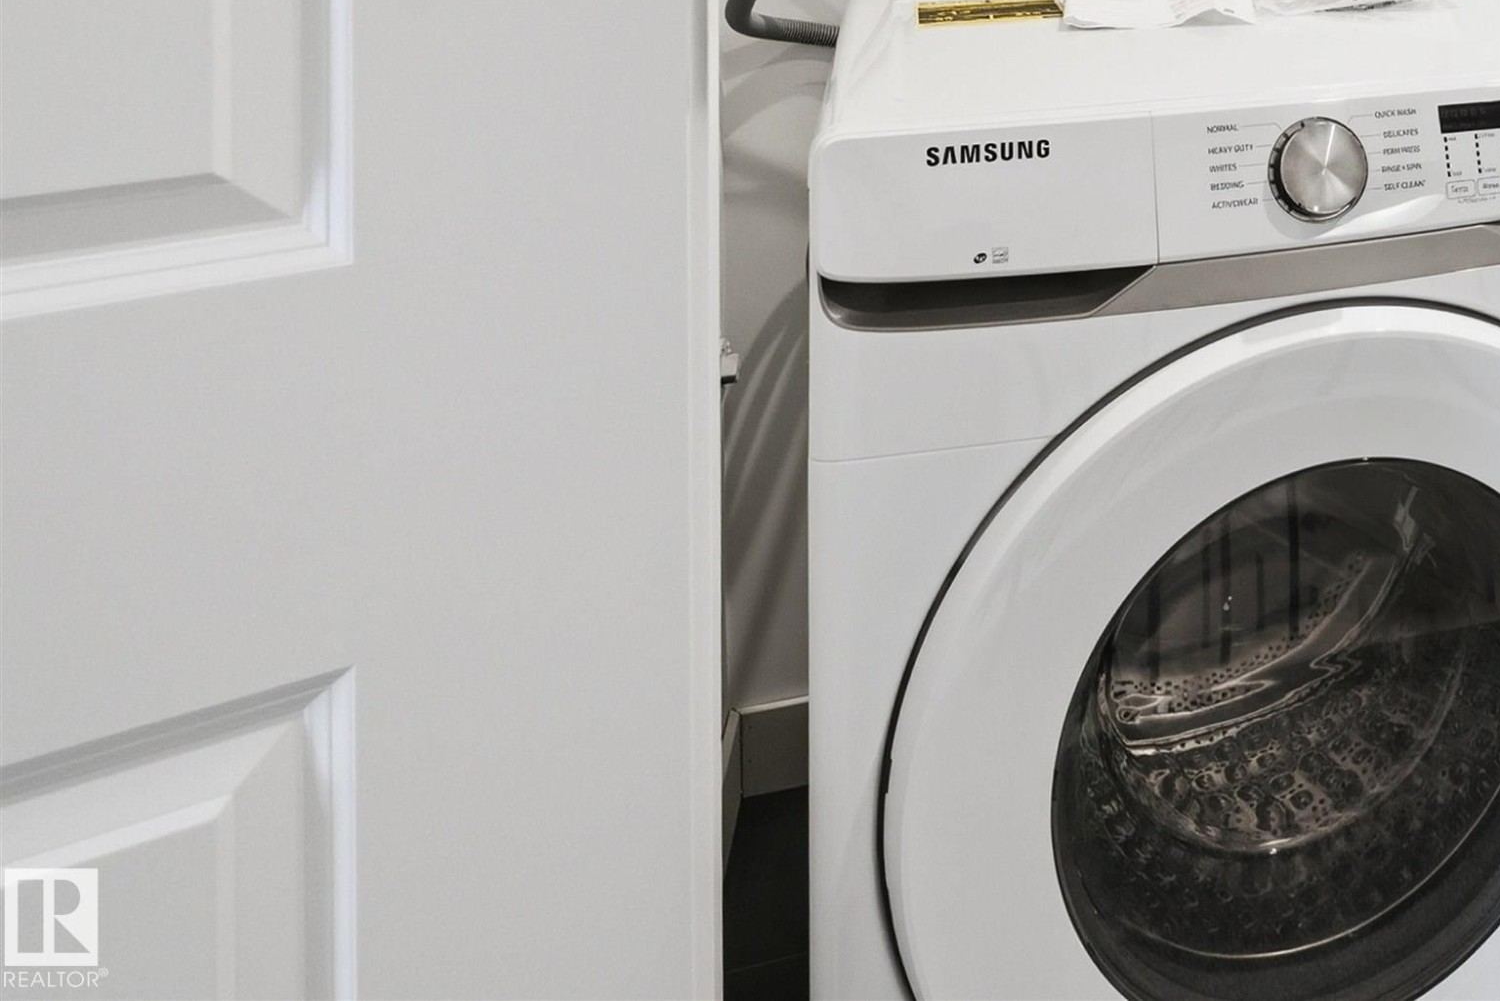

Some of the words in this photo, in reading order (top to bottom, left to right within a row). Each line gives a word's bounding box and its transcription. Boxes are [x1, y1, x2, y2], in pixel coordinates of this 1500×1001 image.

[1206, 124, 1239, 134] NORMAL
[925, 138, 1051, 167] SAMSUNG
[1208, 146, 1233, 155] HEAVY
[1233, 144, 1254, 153] DUTY
[1209, 163, 1237, 173] WHITES
[1210, 180, 1245, 191] BEDDING
[1211, 198, 1259, 209] ACTIVEWEAR
